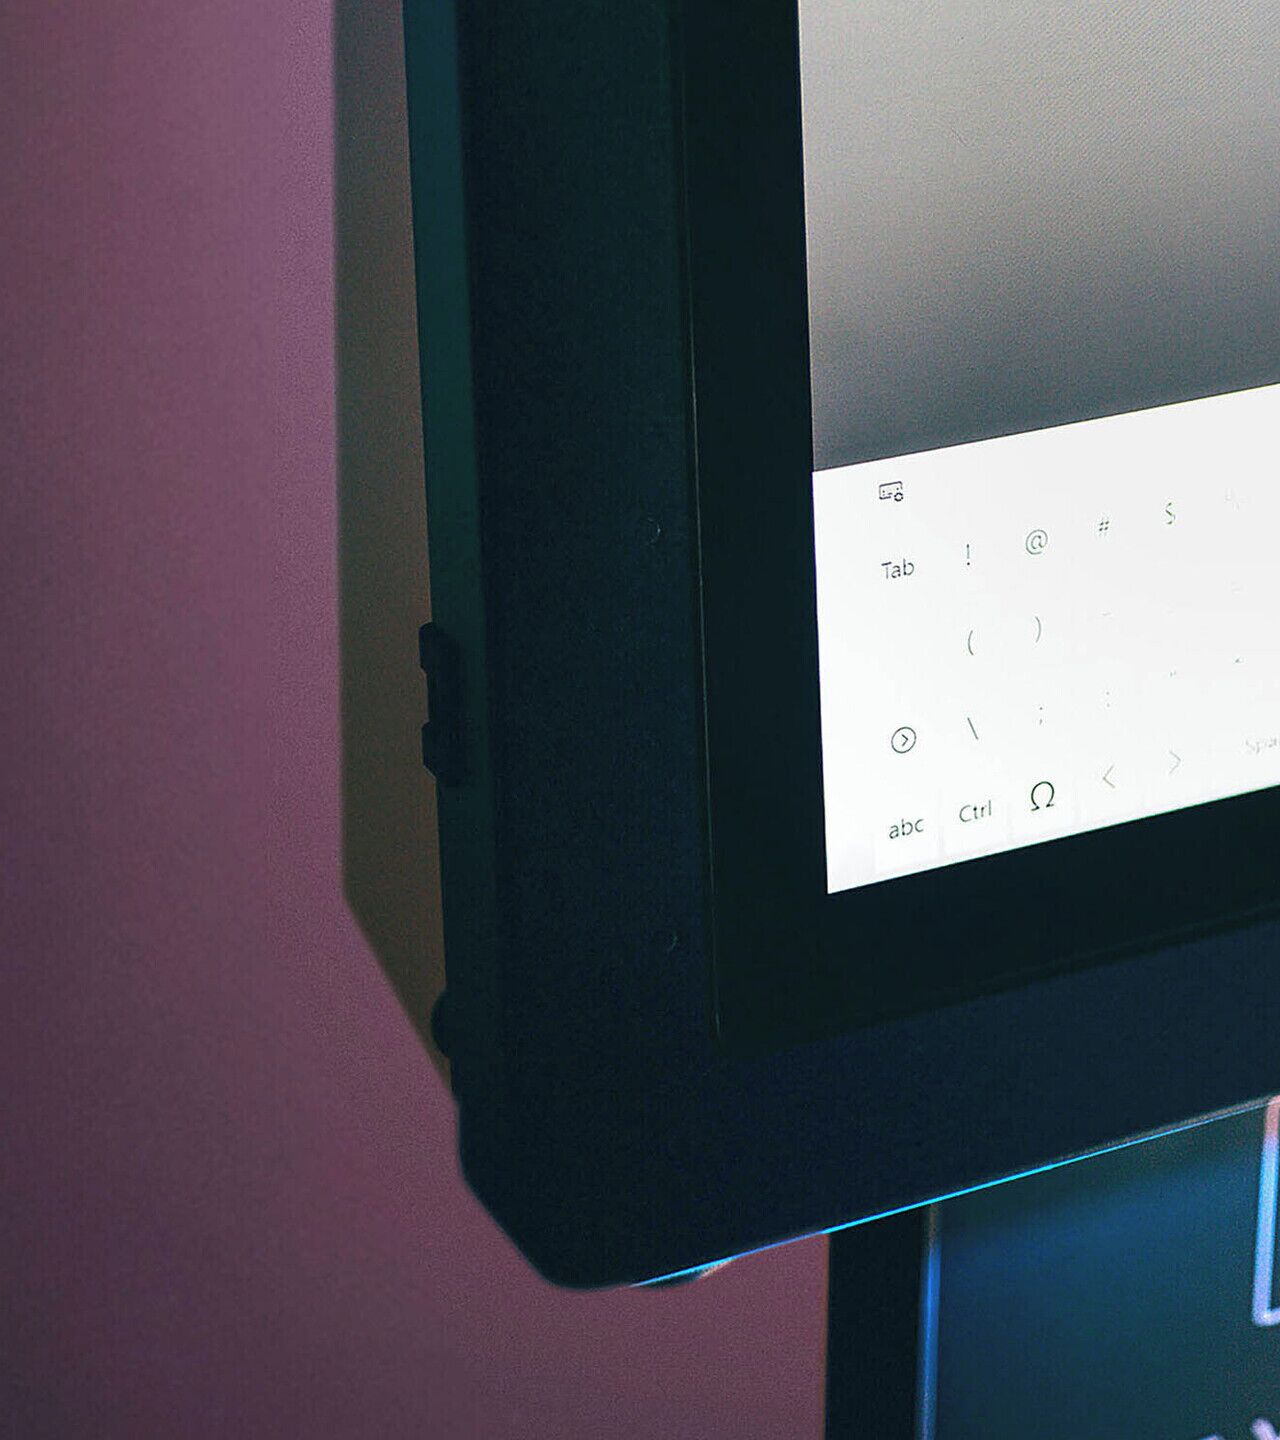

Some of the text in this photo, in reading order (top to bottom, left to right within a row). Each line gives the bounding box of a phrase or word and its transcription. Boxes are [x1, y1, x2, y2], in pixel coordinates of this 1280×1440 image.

[1025, 529, 1048, 555] @
[881, 559, 915, 580] Tab
[959, 800, 992, 823] Ctrl
[888, 818, 925, 840] abc
